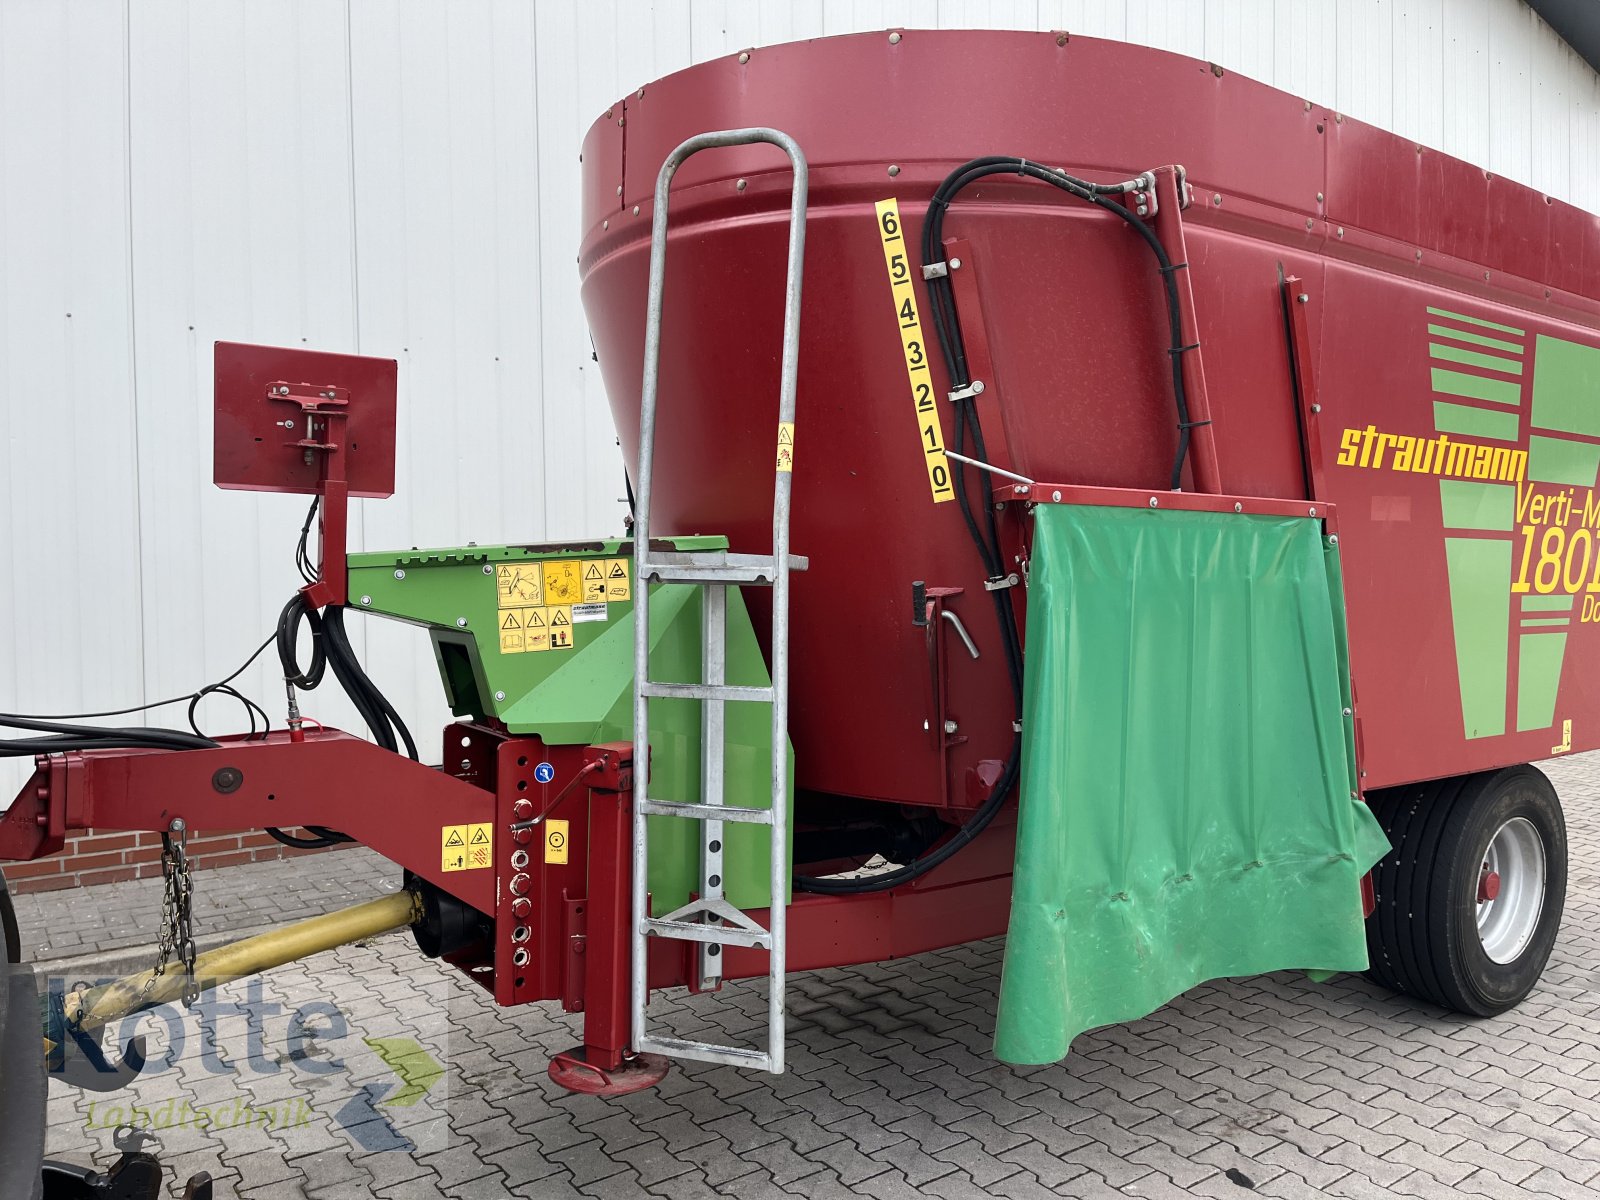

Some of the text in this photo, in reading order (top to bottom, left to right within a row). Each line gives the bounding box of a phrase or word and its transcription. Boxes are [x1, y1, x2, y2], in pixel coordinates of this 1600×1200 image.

[882, 211, 898, 235] 6
[891, 254, 906, 279] 5
[900, 298, 915, 321] 4
[908, 341, 923, 364] 3
[916, 383, 932, 407] 2
[924, 425, 937, 447] 1
[1337, 425, 1528, 482] strautmann
[932, 465, 947, 487] 0
